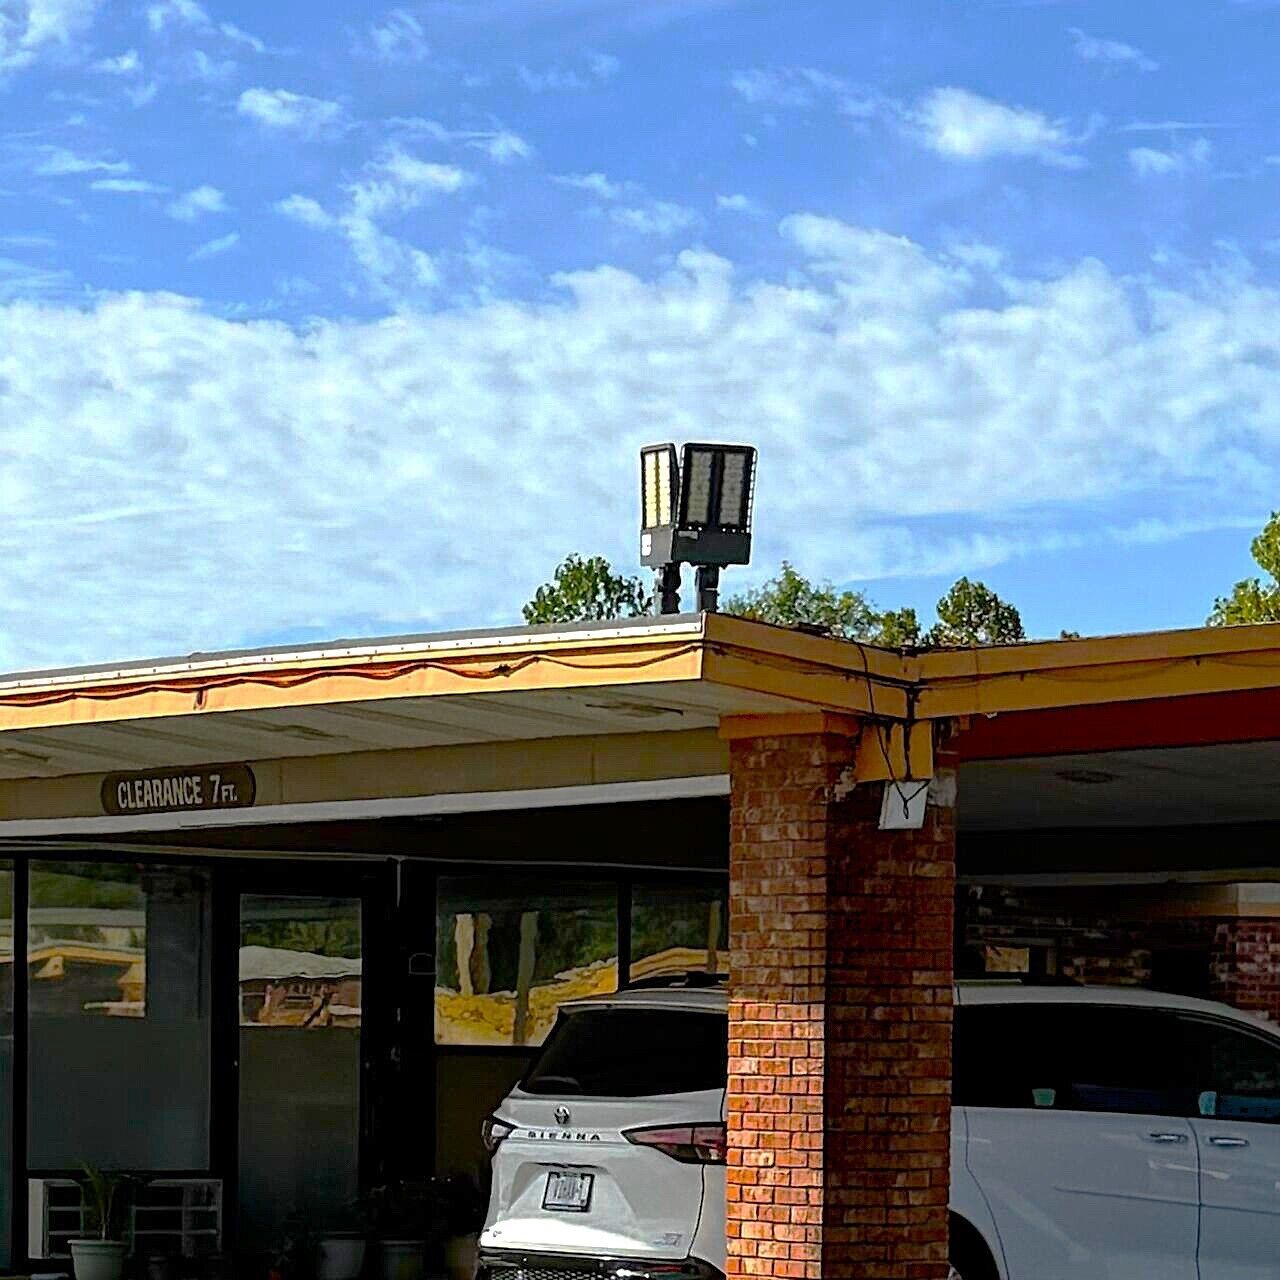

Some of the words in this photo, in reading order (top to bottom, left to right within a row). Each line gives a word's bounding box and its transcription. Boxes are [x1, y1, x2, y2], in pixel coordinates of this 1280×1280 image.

[117, 775, 203, 809] CLEARANCE
[209, 774, 221, 804] 7
[527, 1130, 600, 1141] SIENNA
